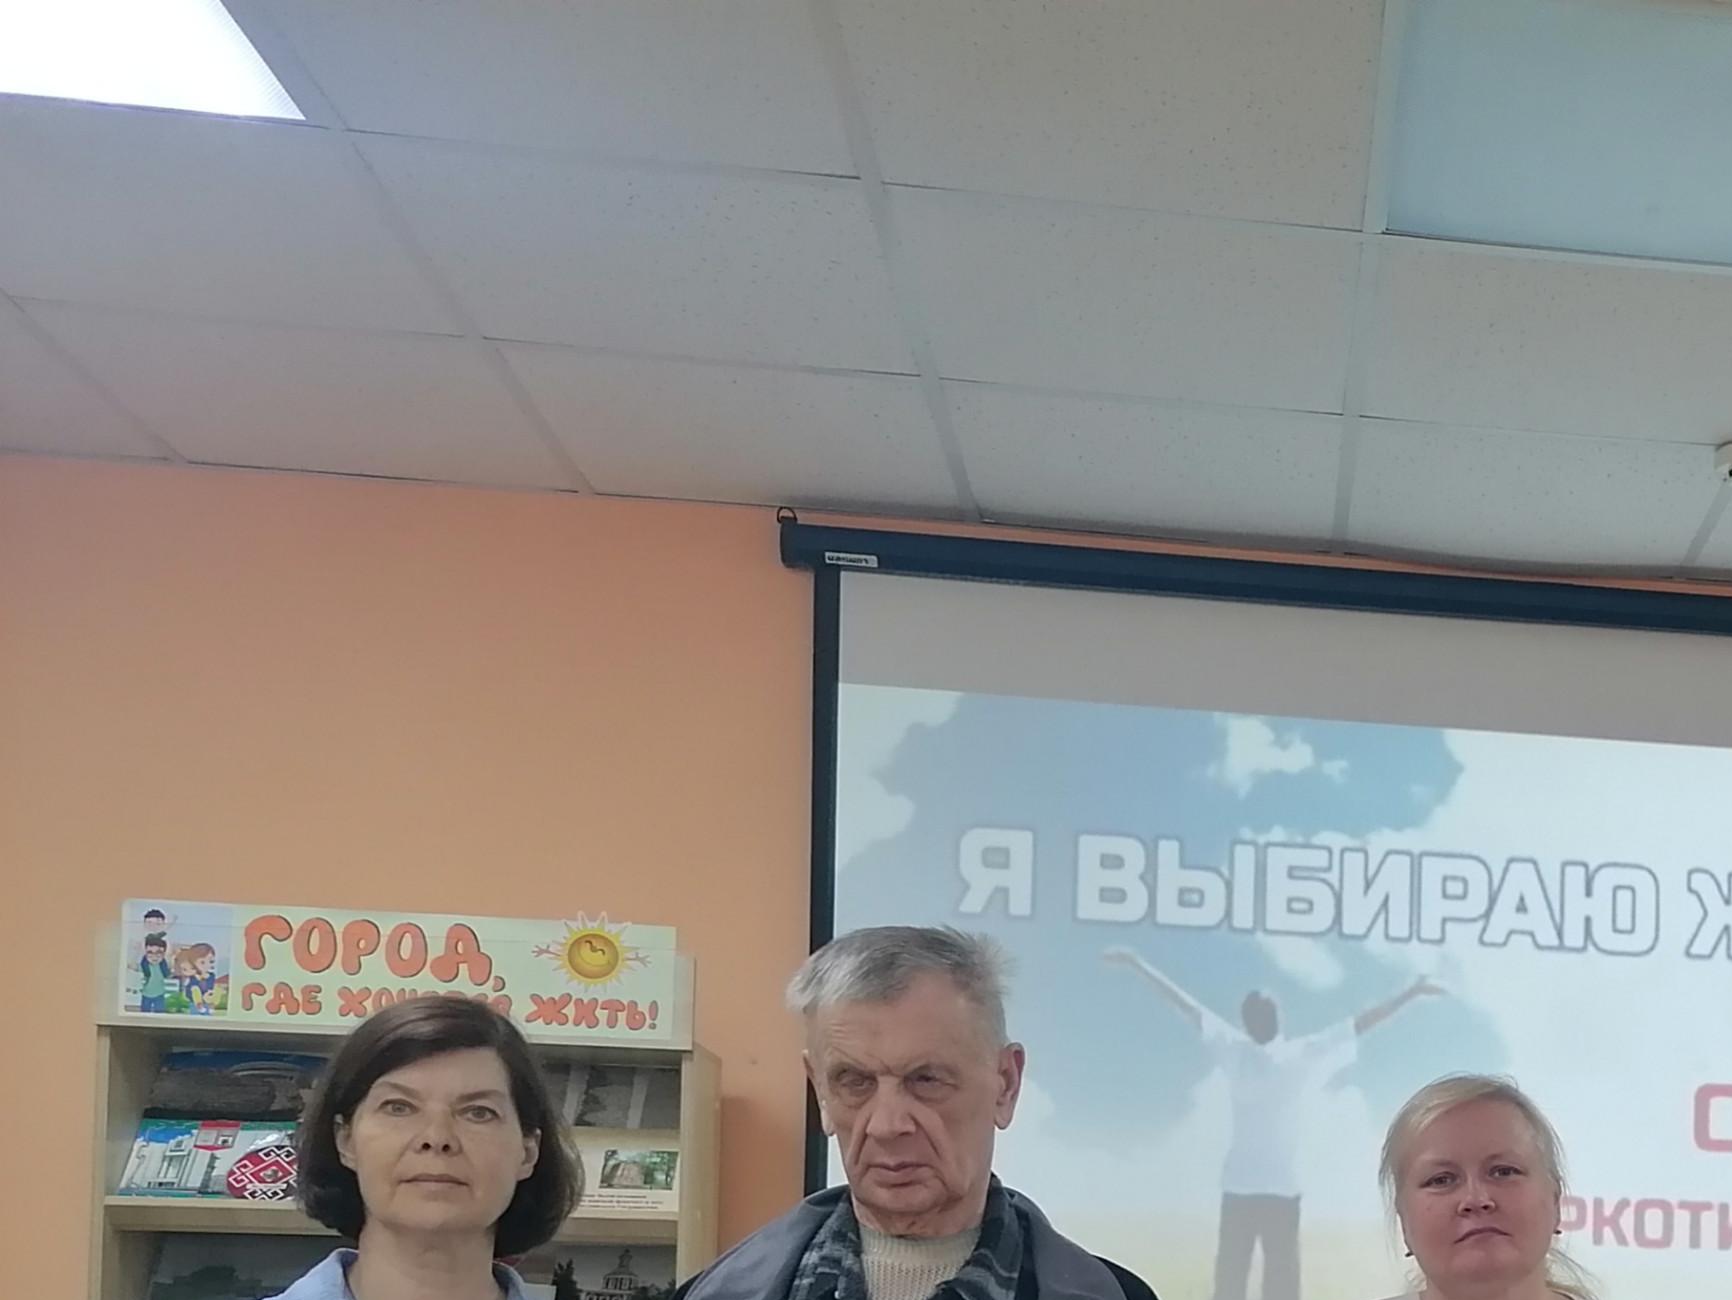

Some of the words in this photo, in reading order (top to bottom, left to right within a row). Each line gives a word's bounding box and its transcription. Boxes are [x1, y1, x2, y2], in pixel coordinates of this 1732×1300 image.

[954, 826, 1036, 918] Я
[1073, 832, 1661, 957] ВЫБИРАЮ
[244, 914, 506, 992] ГОРОД,
[241, 981, 323, 1016] ГДЕ
[525, 992, 659, 1031] ЖИТЬ!
